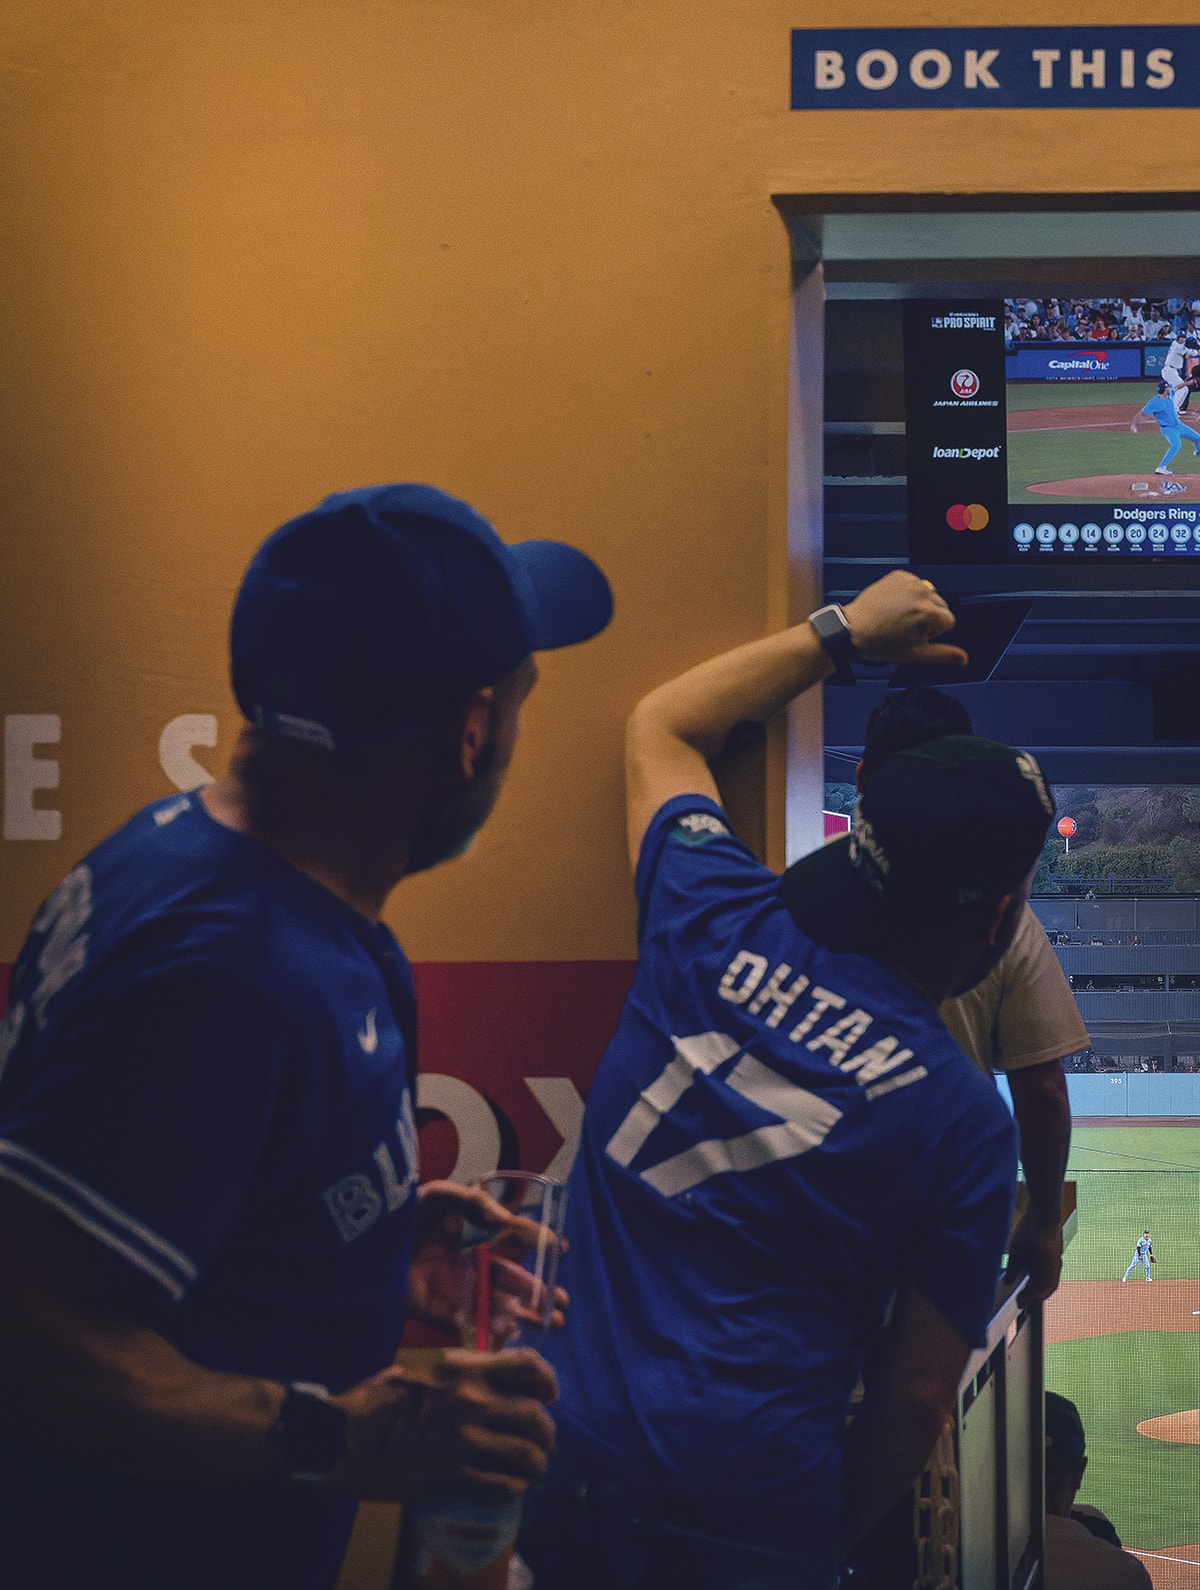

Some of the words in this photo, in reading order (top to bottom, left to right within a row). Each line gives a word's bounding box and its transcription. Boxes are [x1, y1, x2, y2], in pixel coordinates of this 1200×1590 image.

[814, 49, 1000, 91] BOOK
[1033, 49, 1176, 90] THIS
[943, 317, 963, 328] PRO
[963, 317, 996, 328] SPIRIT
[933, 446, 999, 460] loanDepot
[1113, 508, 1166, 521] Dodgers
[1168, 508, 1197, 521] Ring
[1022, 529, 1026, 538] 1
[1043, 529, 1050, 538] 2
[1065, 529, 1072, 538] 4
[1086, 529, 1096, 538] 14
[1109, 529, 1118, 538] 19
[1130, 529, 1142, 538] 20
[1153, 529, 1164, 538] 24
[1175, 529, 1187, 538] 32
[3, 714, 62, 841] E
[718, 949, 929, 1101] OHTANI
[604, 1030, 844, 1198] 17
